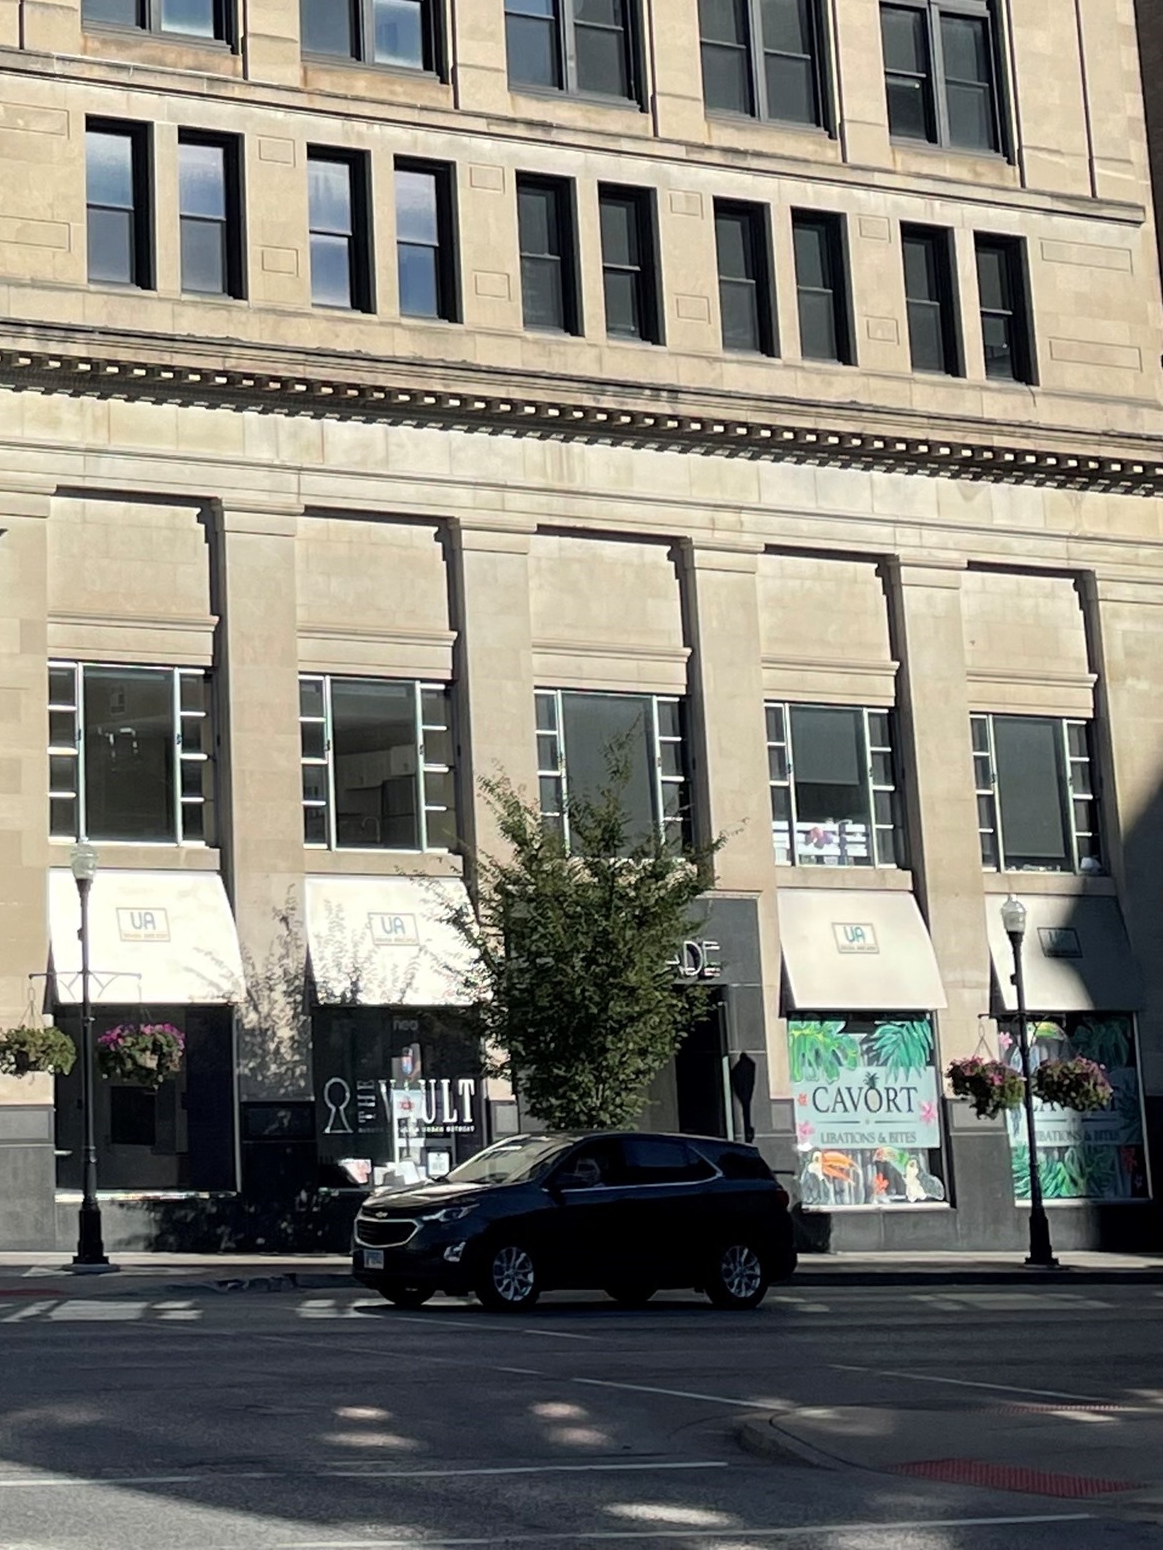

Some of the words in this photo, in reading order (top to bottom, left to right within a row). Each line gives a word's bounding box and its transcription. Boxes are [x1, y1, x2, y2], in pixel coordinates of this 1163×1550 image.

[812, 1086, 919, 1113] CAVORT
[878, 1132, 887, 1144] &
[889, 1131, 917, 1144] BITES
[1036, 1130, 1081, 1142] BATIONS
